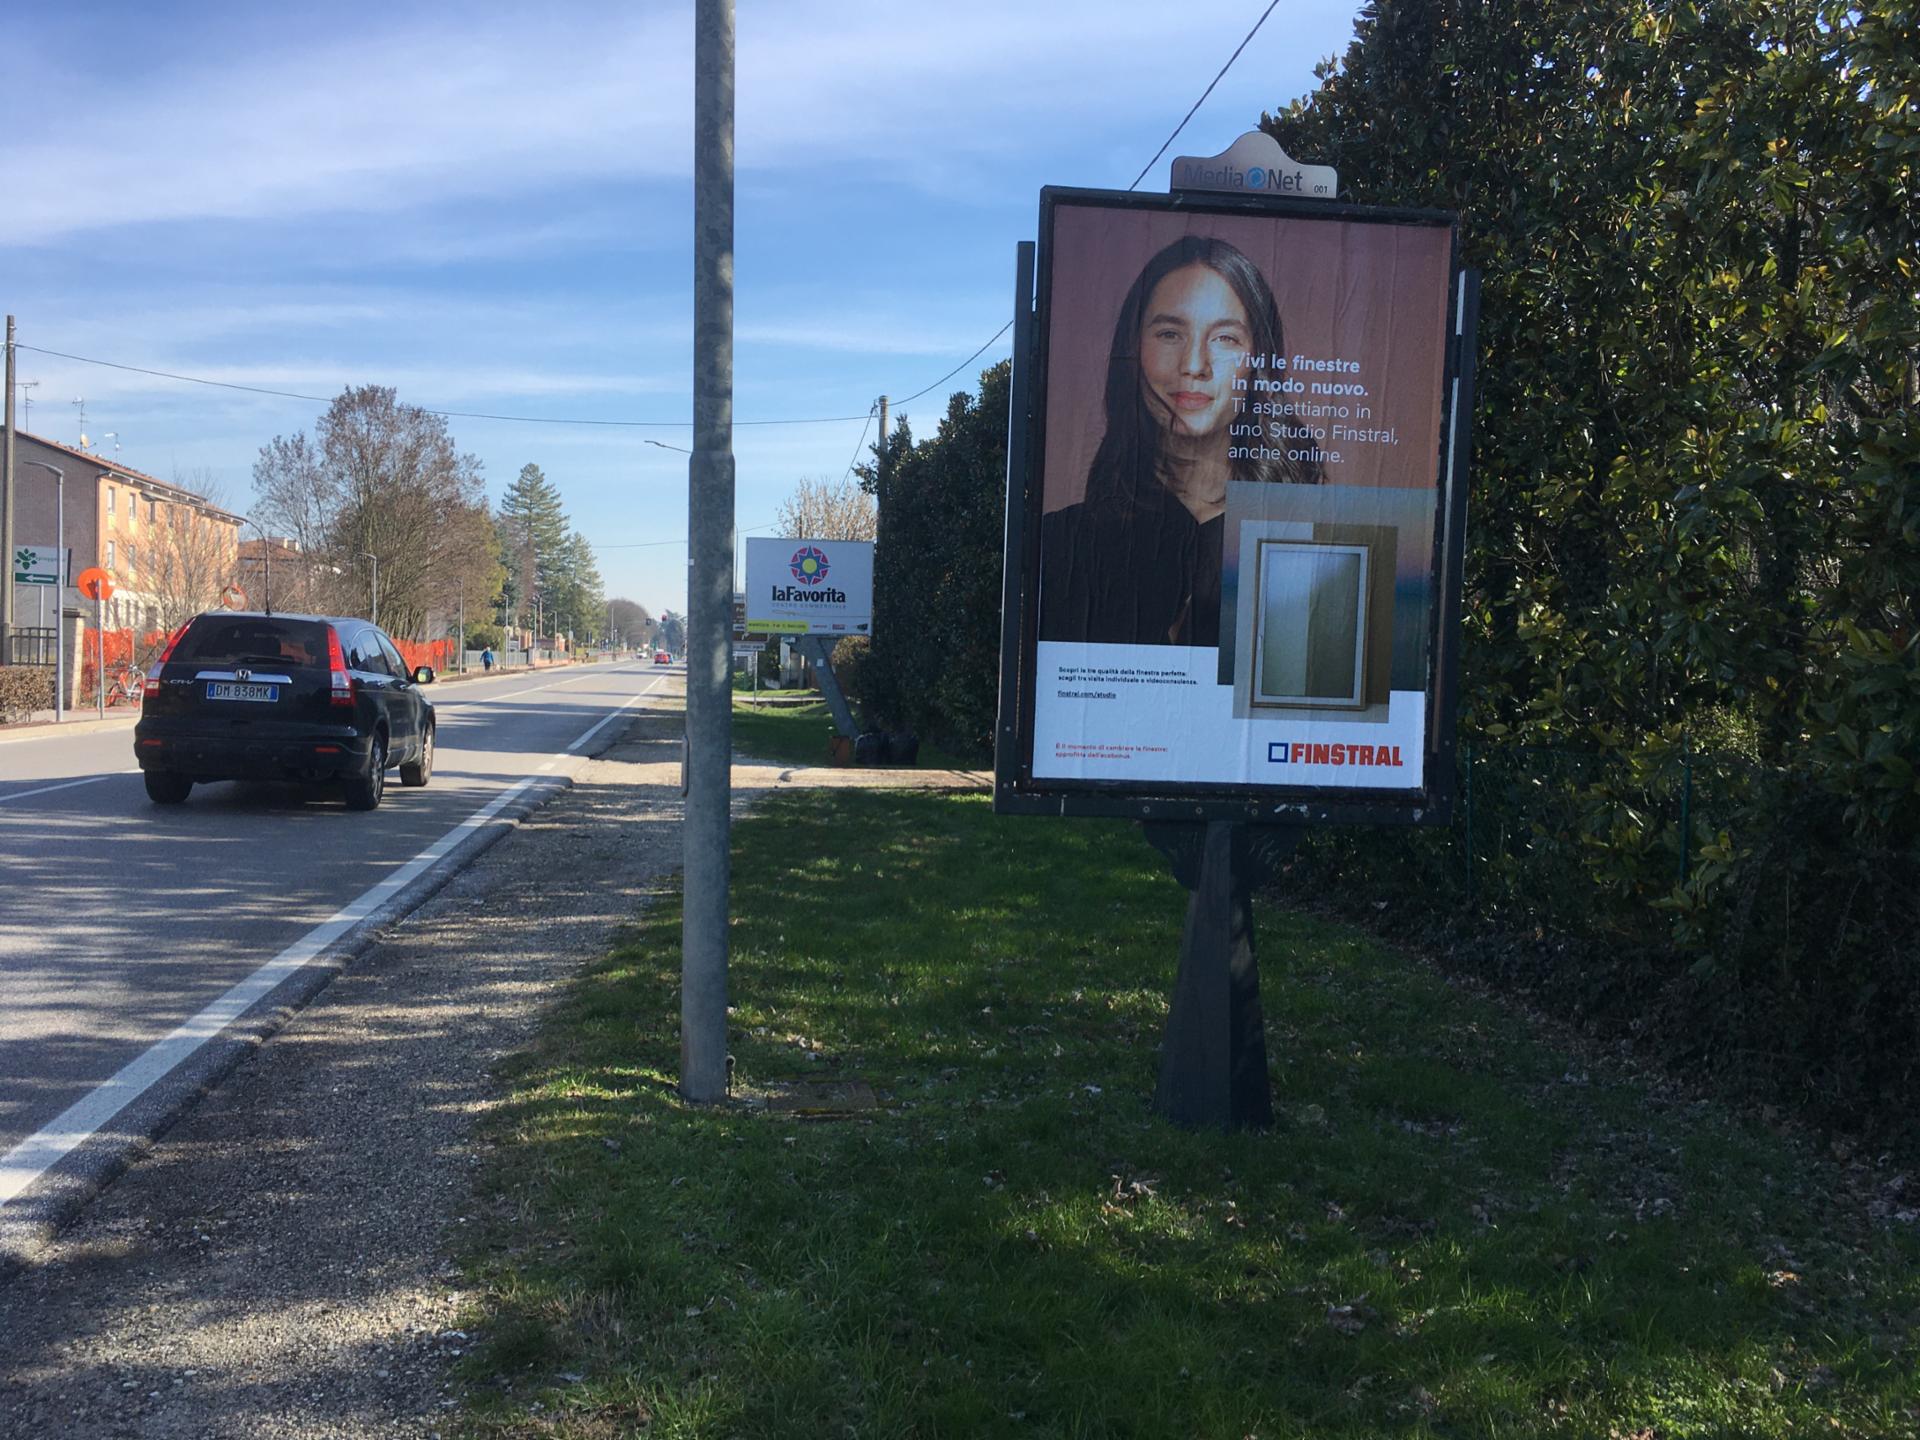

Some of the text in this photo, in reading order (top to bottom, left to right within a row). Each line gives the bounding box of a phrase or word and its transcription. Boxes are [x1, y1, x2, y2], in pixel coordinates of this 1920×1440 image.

[1184, 164, 1328, 194] Media Net 001
[1233, 352, 1360, 373] Vivi le finestre
[1232, 375, 1368, 396] in modo nuovo.
[1231, 397, 1371, 419] Ti aspettiamo in
[1229, 422, 1399, 445] uno Studio Finstral,
[1228, 444, 1345, 463] anche online.
[771, 585, 846, 603] laFavorita
[215, 684, 270, 699] DM 838MK
[1291, 742, 1403, 767] FINSTRAL
